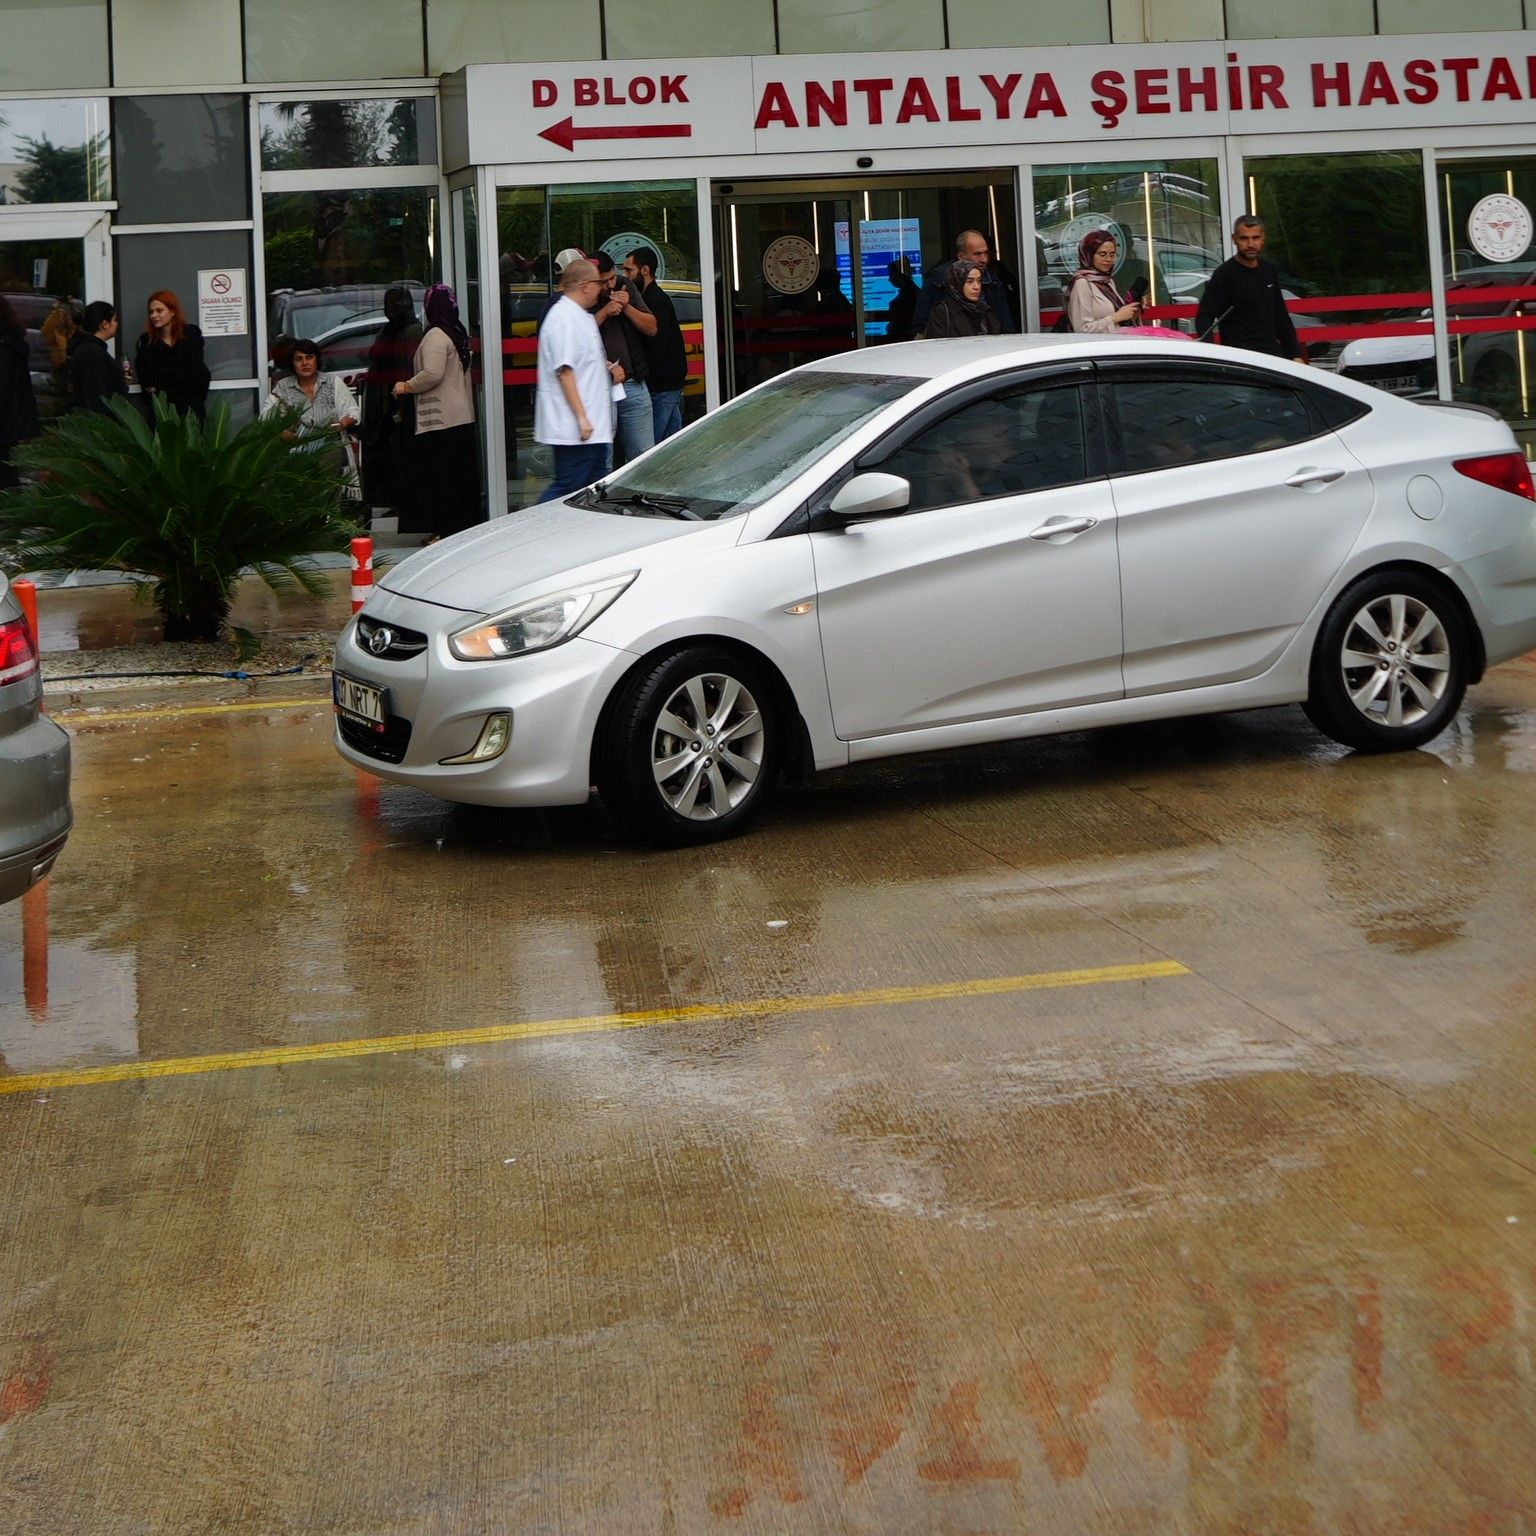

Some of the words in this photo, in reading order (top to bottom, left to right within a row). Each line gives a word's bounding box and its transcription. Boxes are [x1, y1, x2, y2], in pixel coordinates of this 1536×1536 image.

[532, 79, 559, 108] D
[574, 75, 690, 107] BLOK
[754, 72, 1068, 130] ANTALYA
[1090, 52, 1286, 129] ŞEHİR
